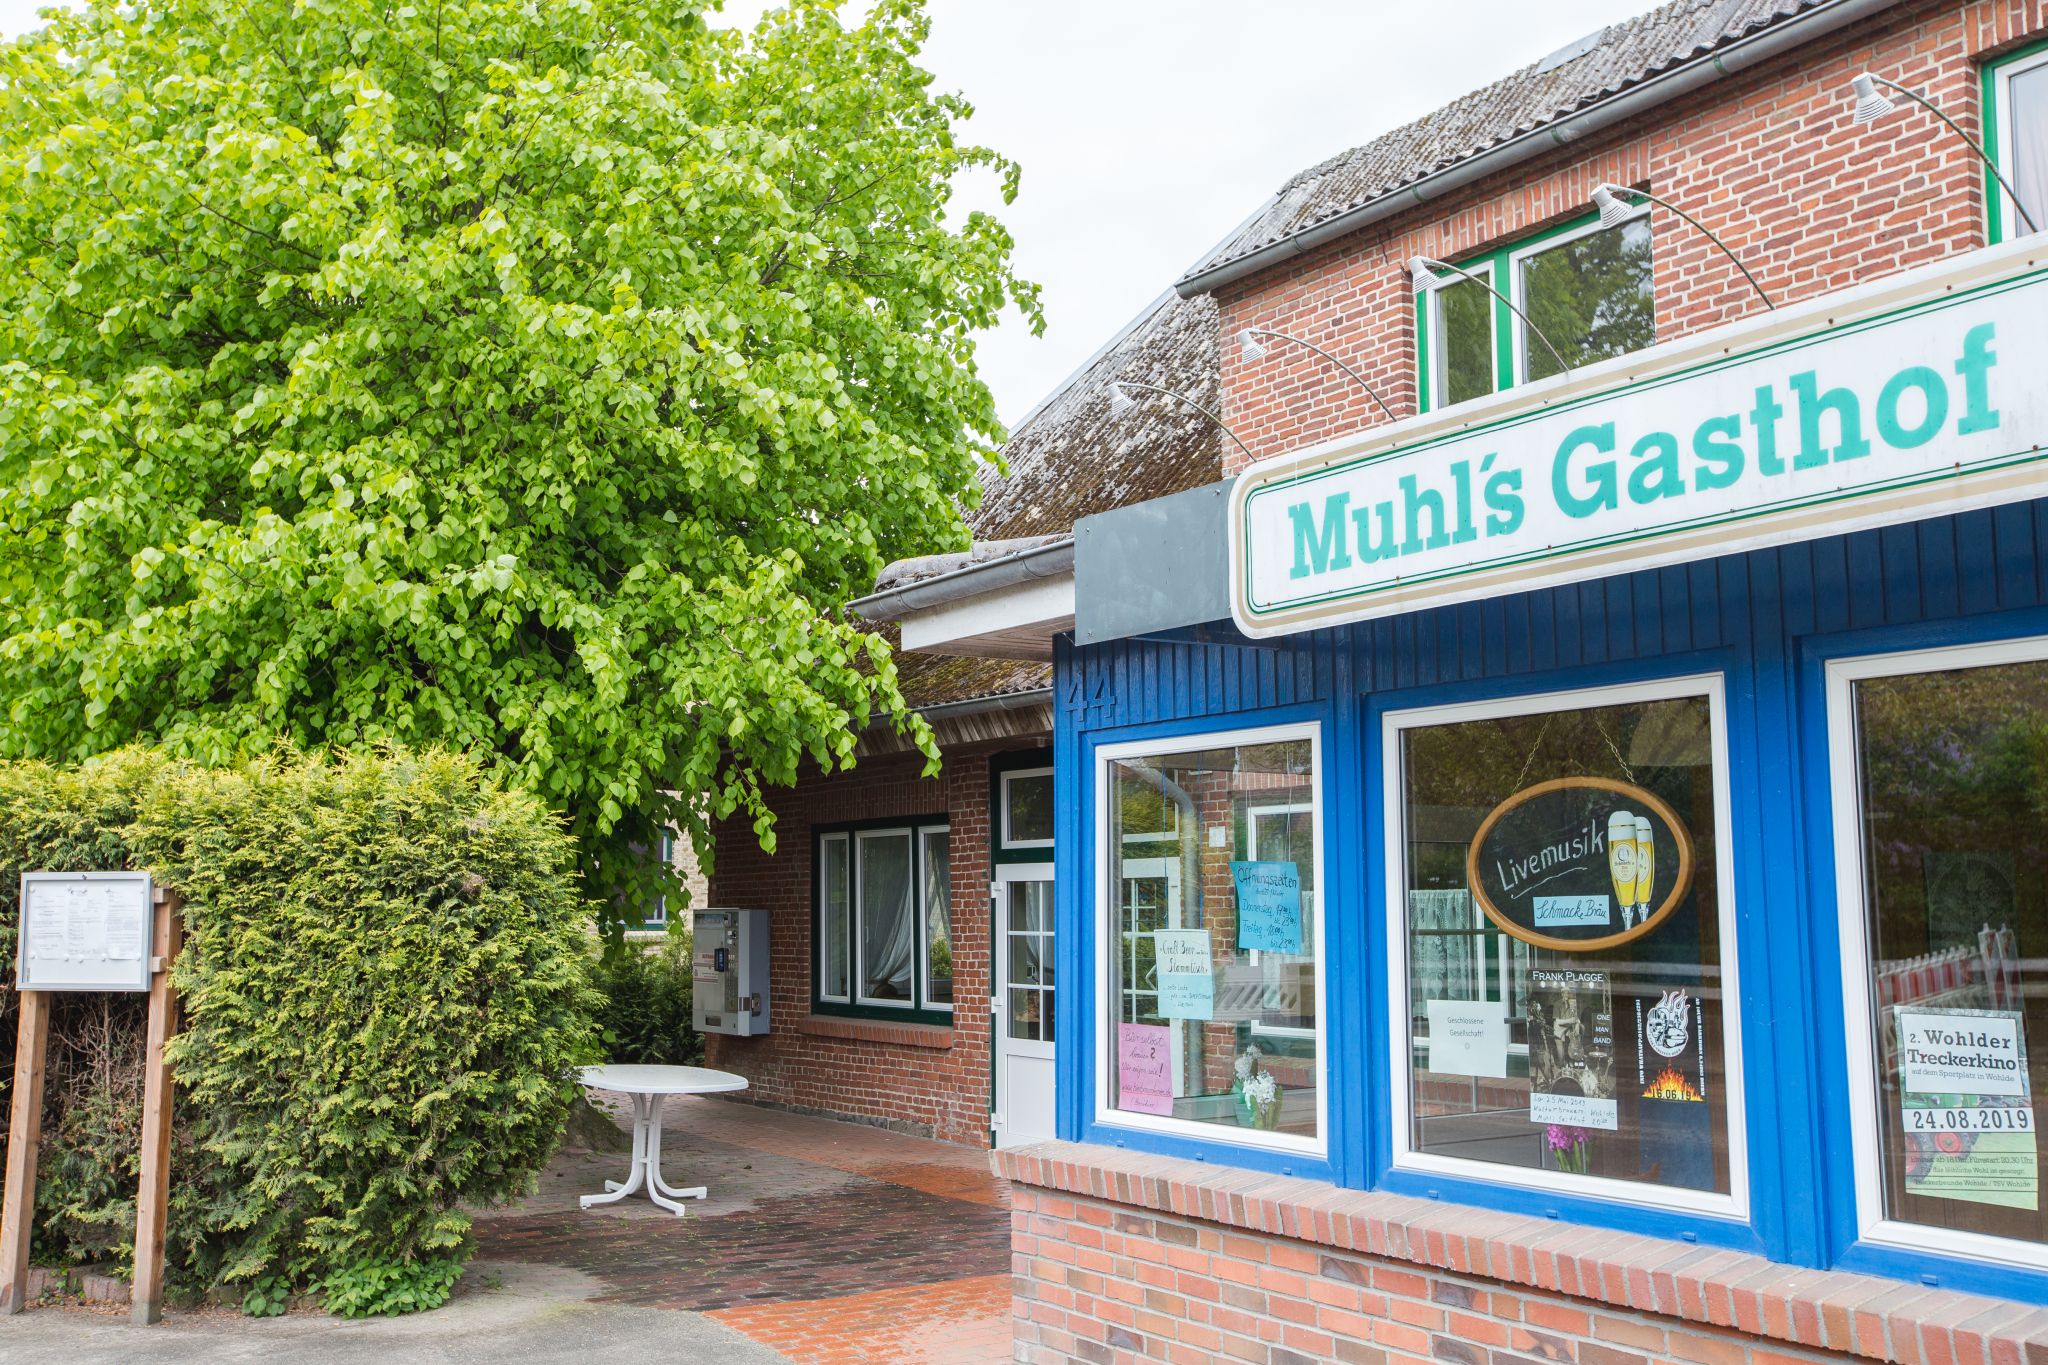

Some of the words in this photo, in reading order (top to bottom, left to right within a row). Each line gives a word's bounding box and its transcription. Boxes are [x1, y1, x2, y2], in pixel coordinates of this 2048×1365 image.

[1551, 322, 2001, 519] Gasthof
[1496, 818, 1604, 892] Livemusik
[1533, 970, 1564, 981] FRANK
[1566, 971, 1604, 982] PLAGGE
[1447, 1016, 1484, 1025] Geschlossene
[1593, 1037, 1612, 1045] BAND
[1910, 1033, 1921, 1044] 2.
[1924, 1029, 2011, 1049] Wohlder
[1907, 1049, 2017, 1070] Treckerkino
[1938, 1069, 1976, 1080] Sportplatz
[1977, 1072, 1985, 1080] in
[1985, 1073, 2015, 1082] Wohlde
[1913, 1109, 2029, 1130] 24.08.2019
